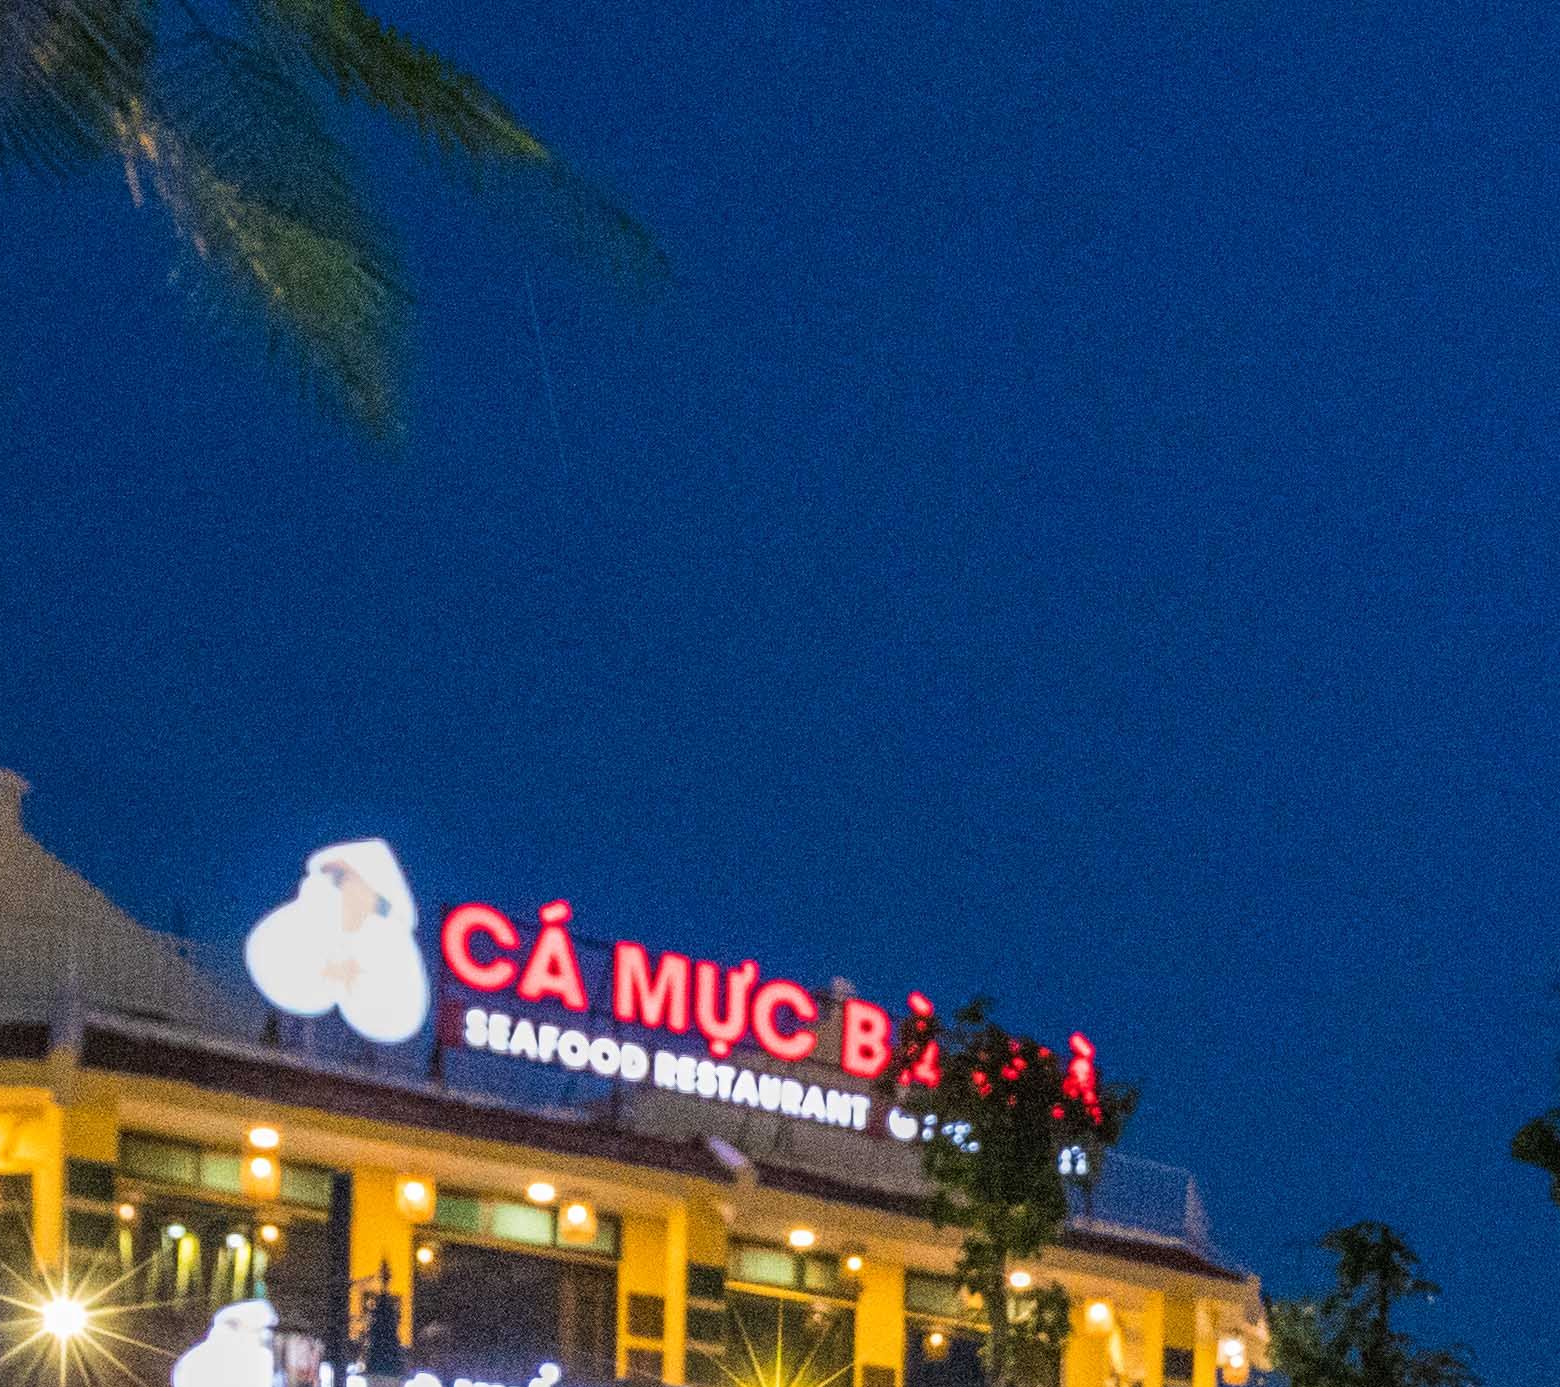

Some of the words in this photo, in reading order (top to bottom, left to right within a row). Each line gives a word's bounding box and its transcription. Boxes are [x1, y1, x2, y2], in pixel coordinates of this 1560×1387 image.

[441, 899, 589, 1012] CÁ
[613, 941, 819, 1062] MỰC
[465, 1008, 649, 1081] SEAFOOD
[654, 1051, 870, 1130] RESTAURANT
